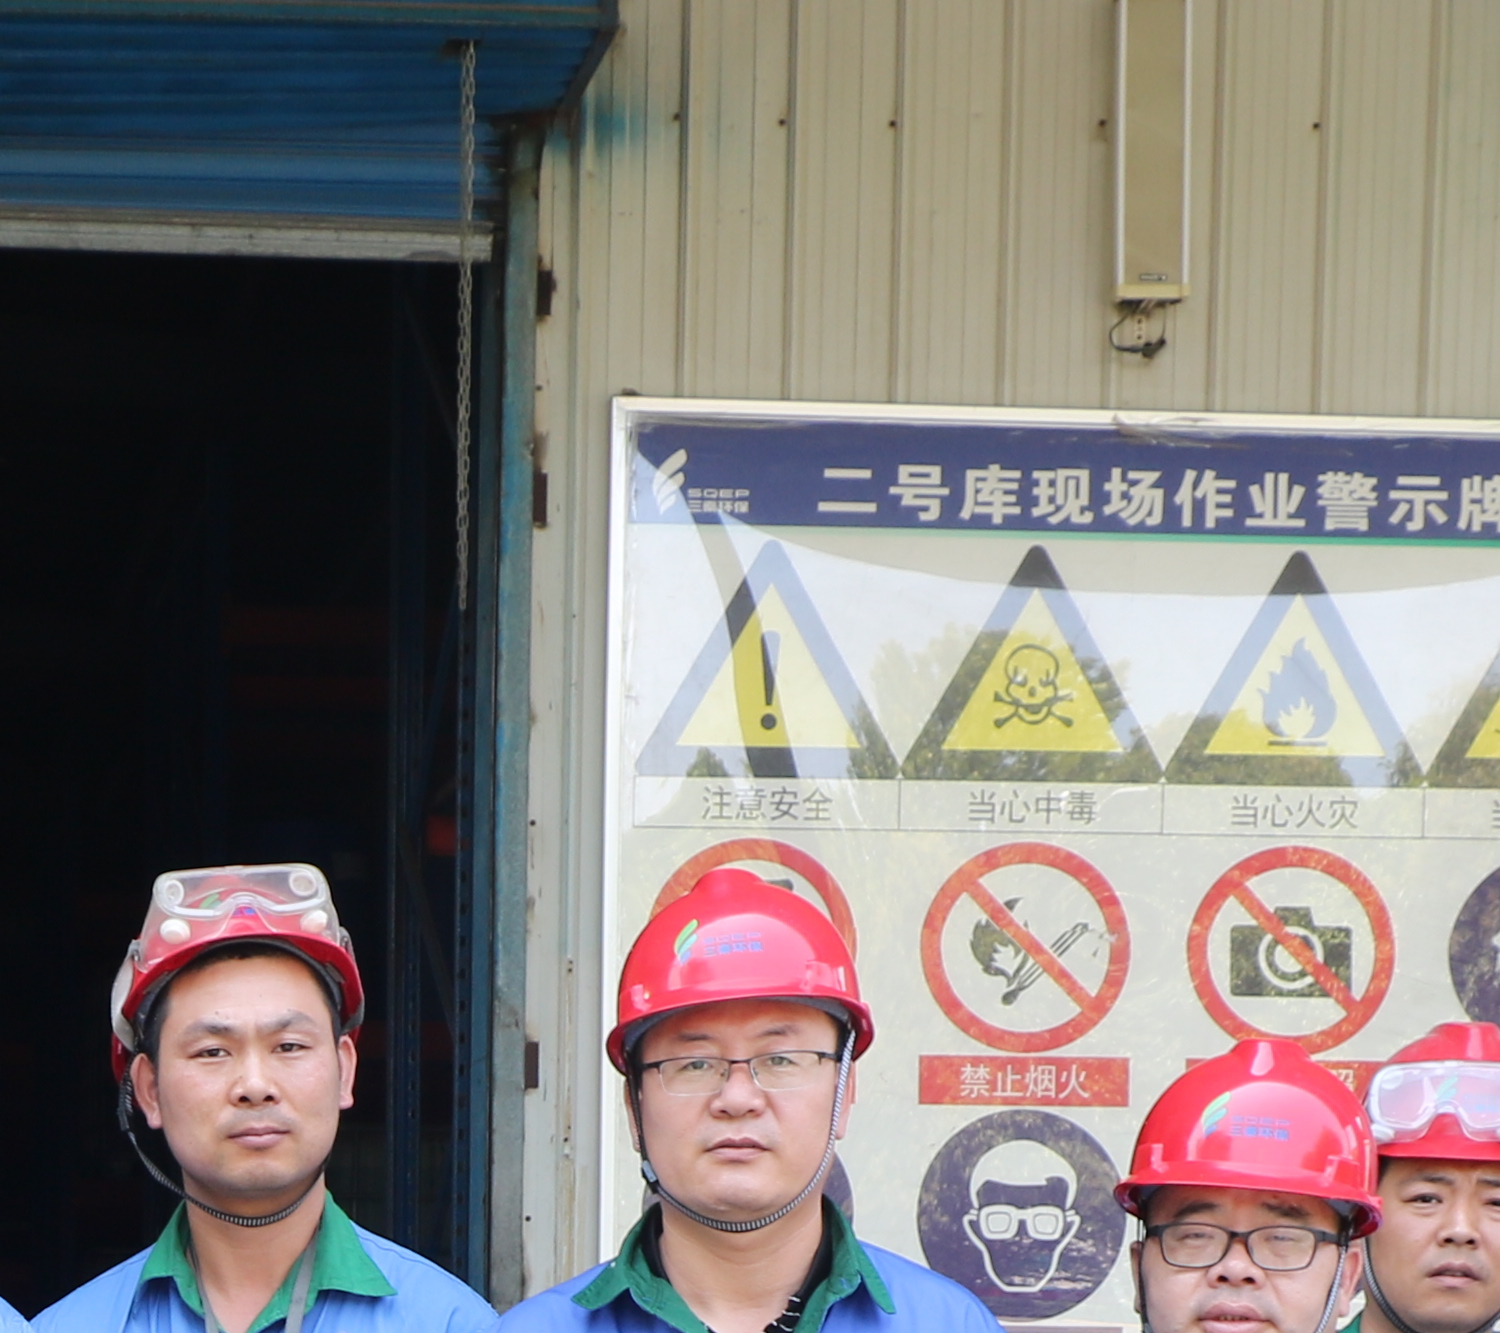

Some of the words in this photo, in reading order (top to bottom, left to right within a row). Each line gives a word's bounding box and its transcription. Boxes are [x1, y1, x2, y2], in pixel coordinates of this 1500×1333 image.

[687, 488, 749, 498] SQEP
[700, 786, 834, 825] 注意安全
[966, 790, 1098, 827] 当心中毒
[1231, 793, 1359, 831] 当心火灾
[959, 1064, 1089, 1101] 禁止烟火
